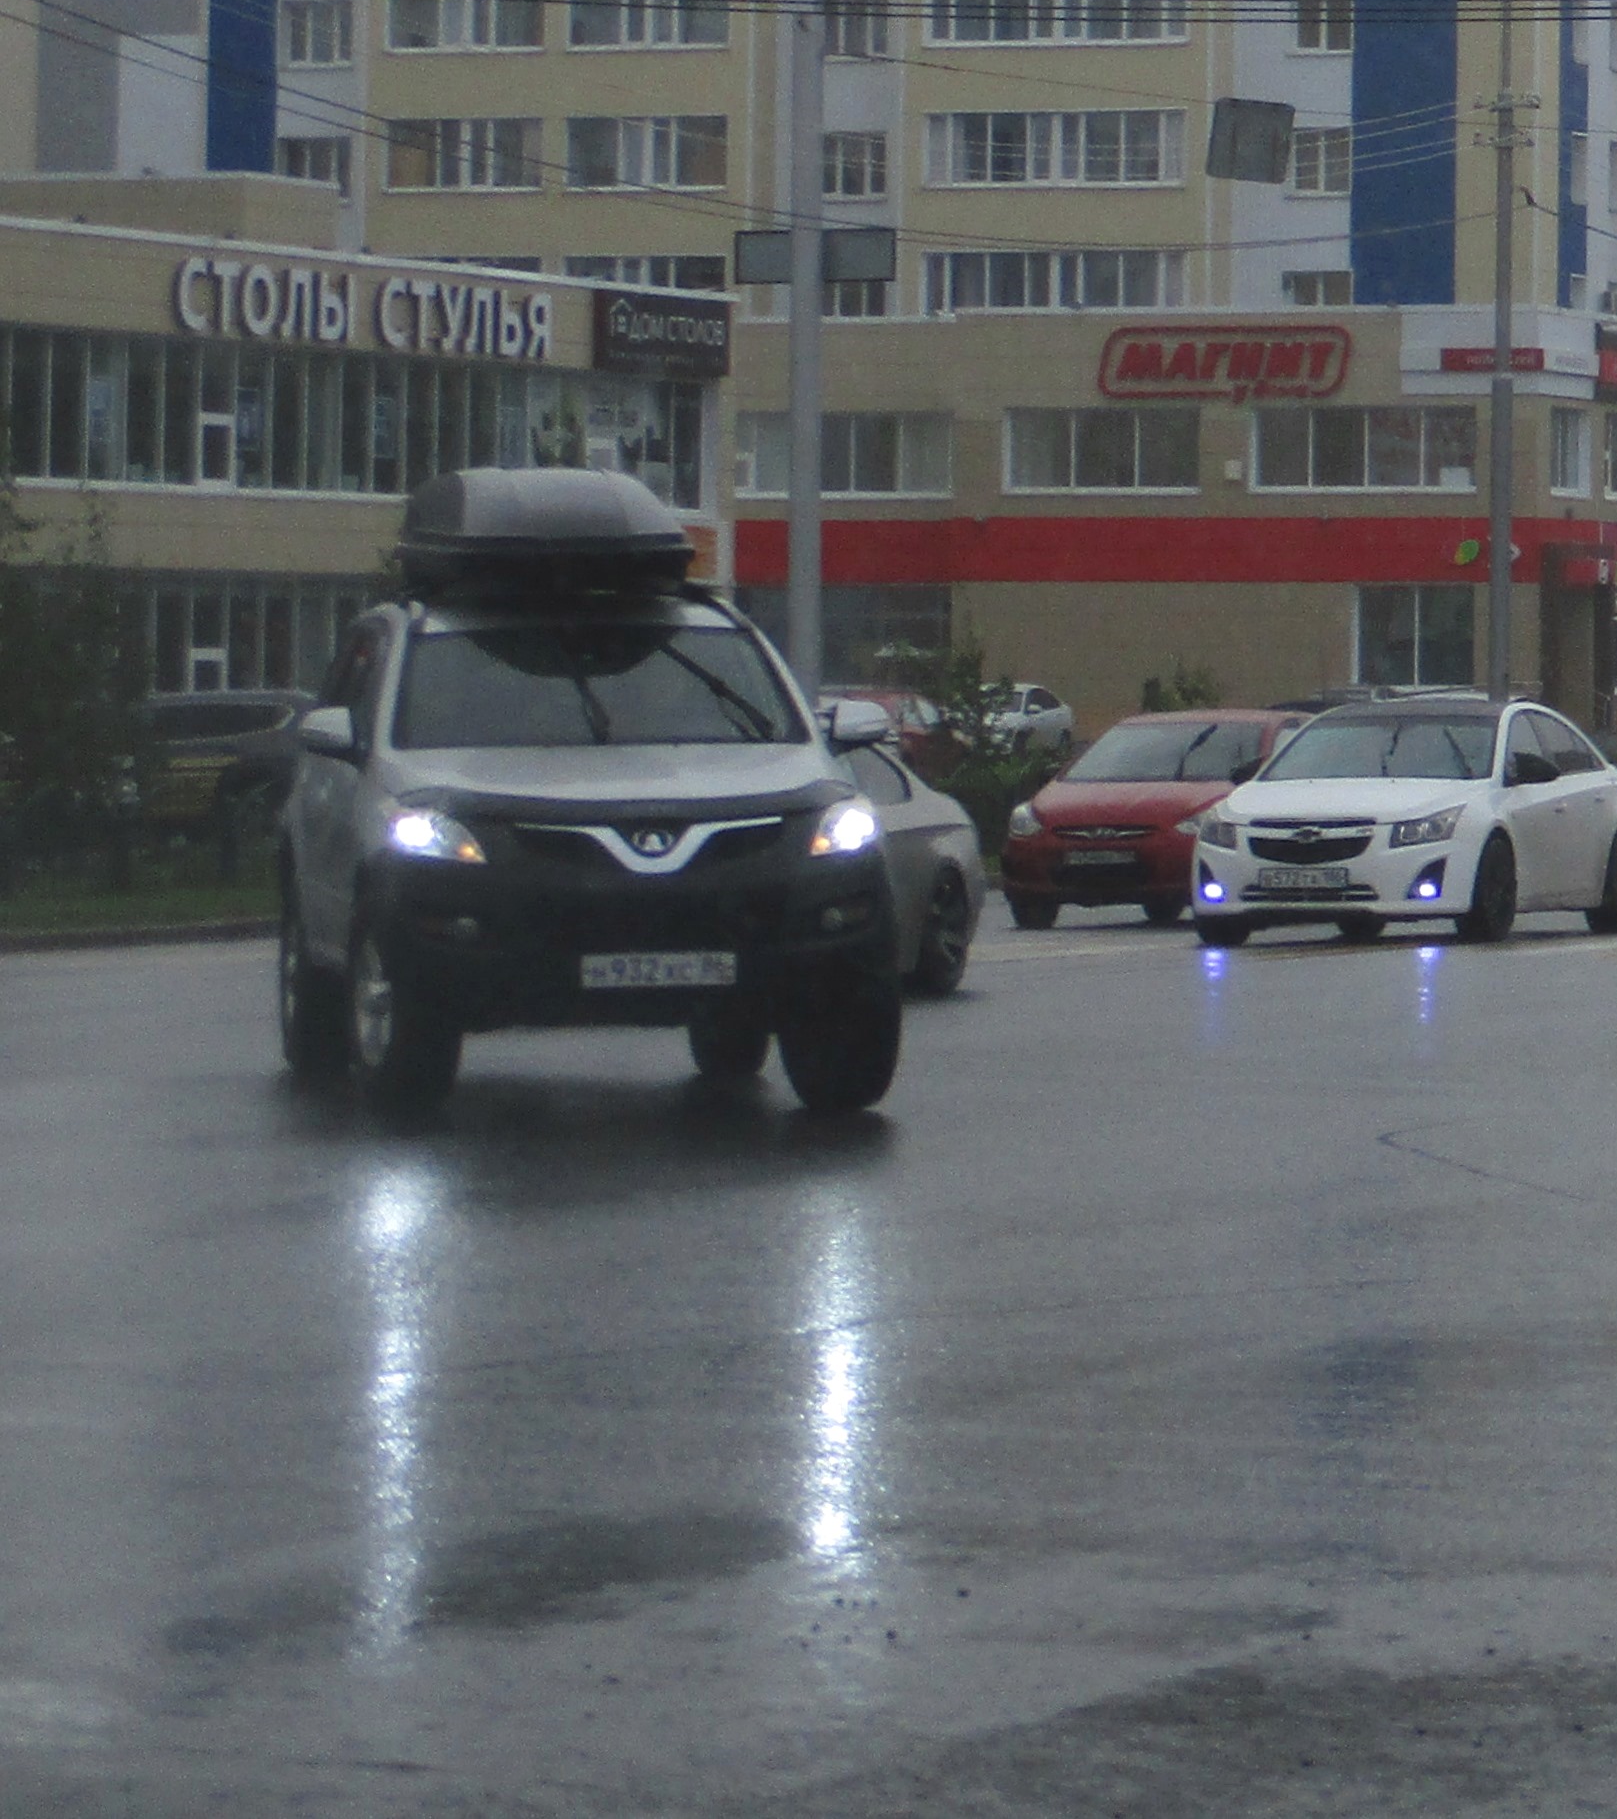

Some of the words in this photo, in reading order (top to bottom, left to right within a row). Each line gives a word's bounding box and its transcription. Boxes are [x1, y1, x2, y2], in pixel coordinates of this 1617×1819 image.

[179, 256, 358, 342] СТОЛЫ
[379, 277, 552, 359] СТУЛЬЯ
[1115, 341, 1336, 380] МАГНИТ
